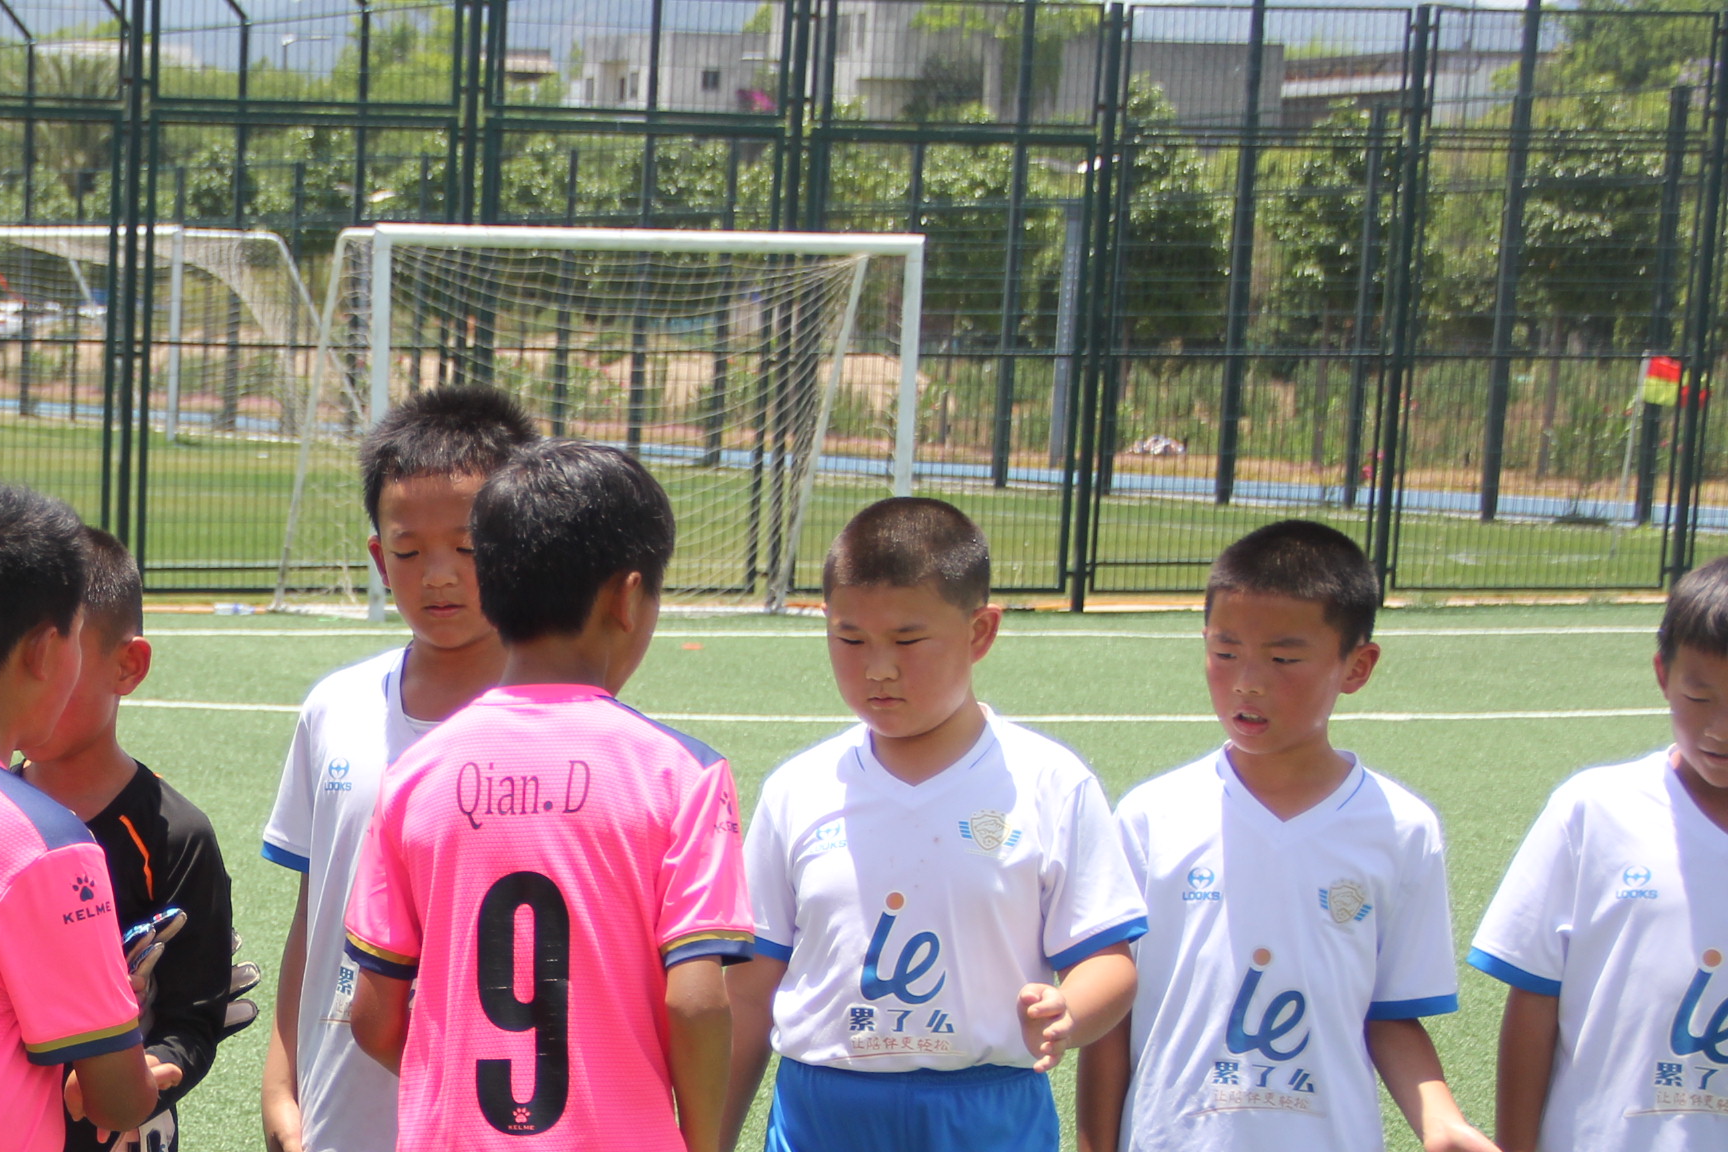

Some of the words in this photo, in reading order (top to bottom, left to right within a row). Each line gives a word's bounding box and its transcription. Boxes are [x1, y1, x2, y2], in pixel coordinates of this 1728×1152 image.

[1182, 891, 1220, 901] LOOKS
[62, 900, 111, 925] KELME
[476, 870, 570, 1136] 9
[849, 1008, 954, 1034] 累了么
[1213, 1061, 1315, 1093] 累了么
[1654, 1062, 1719, 1090] 累了
